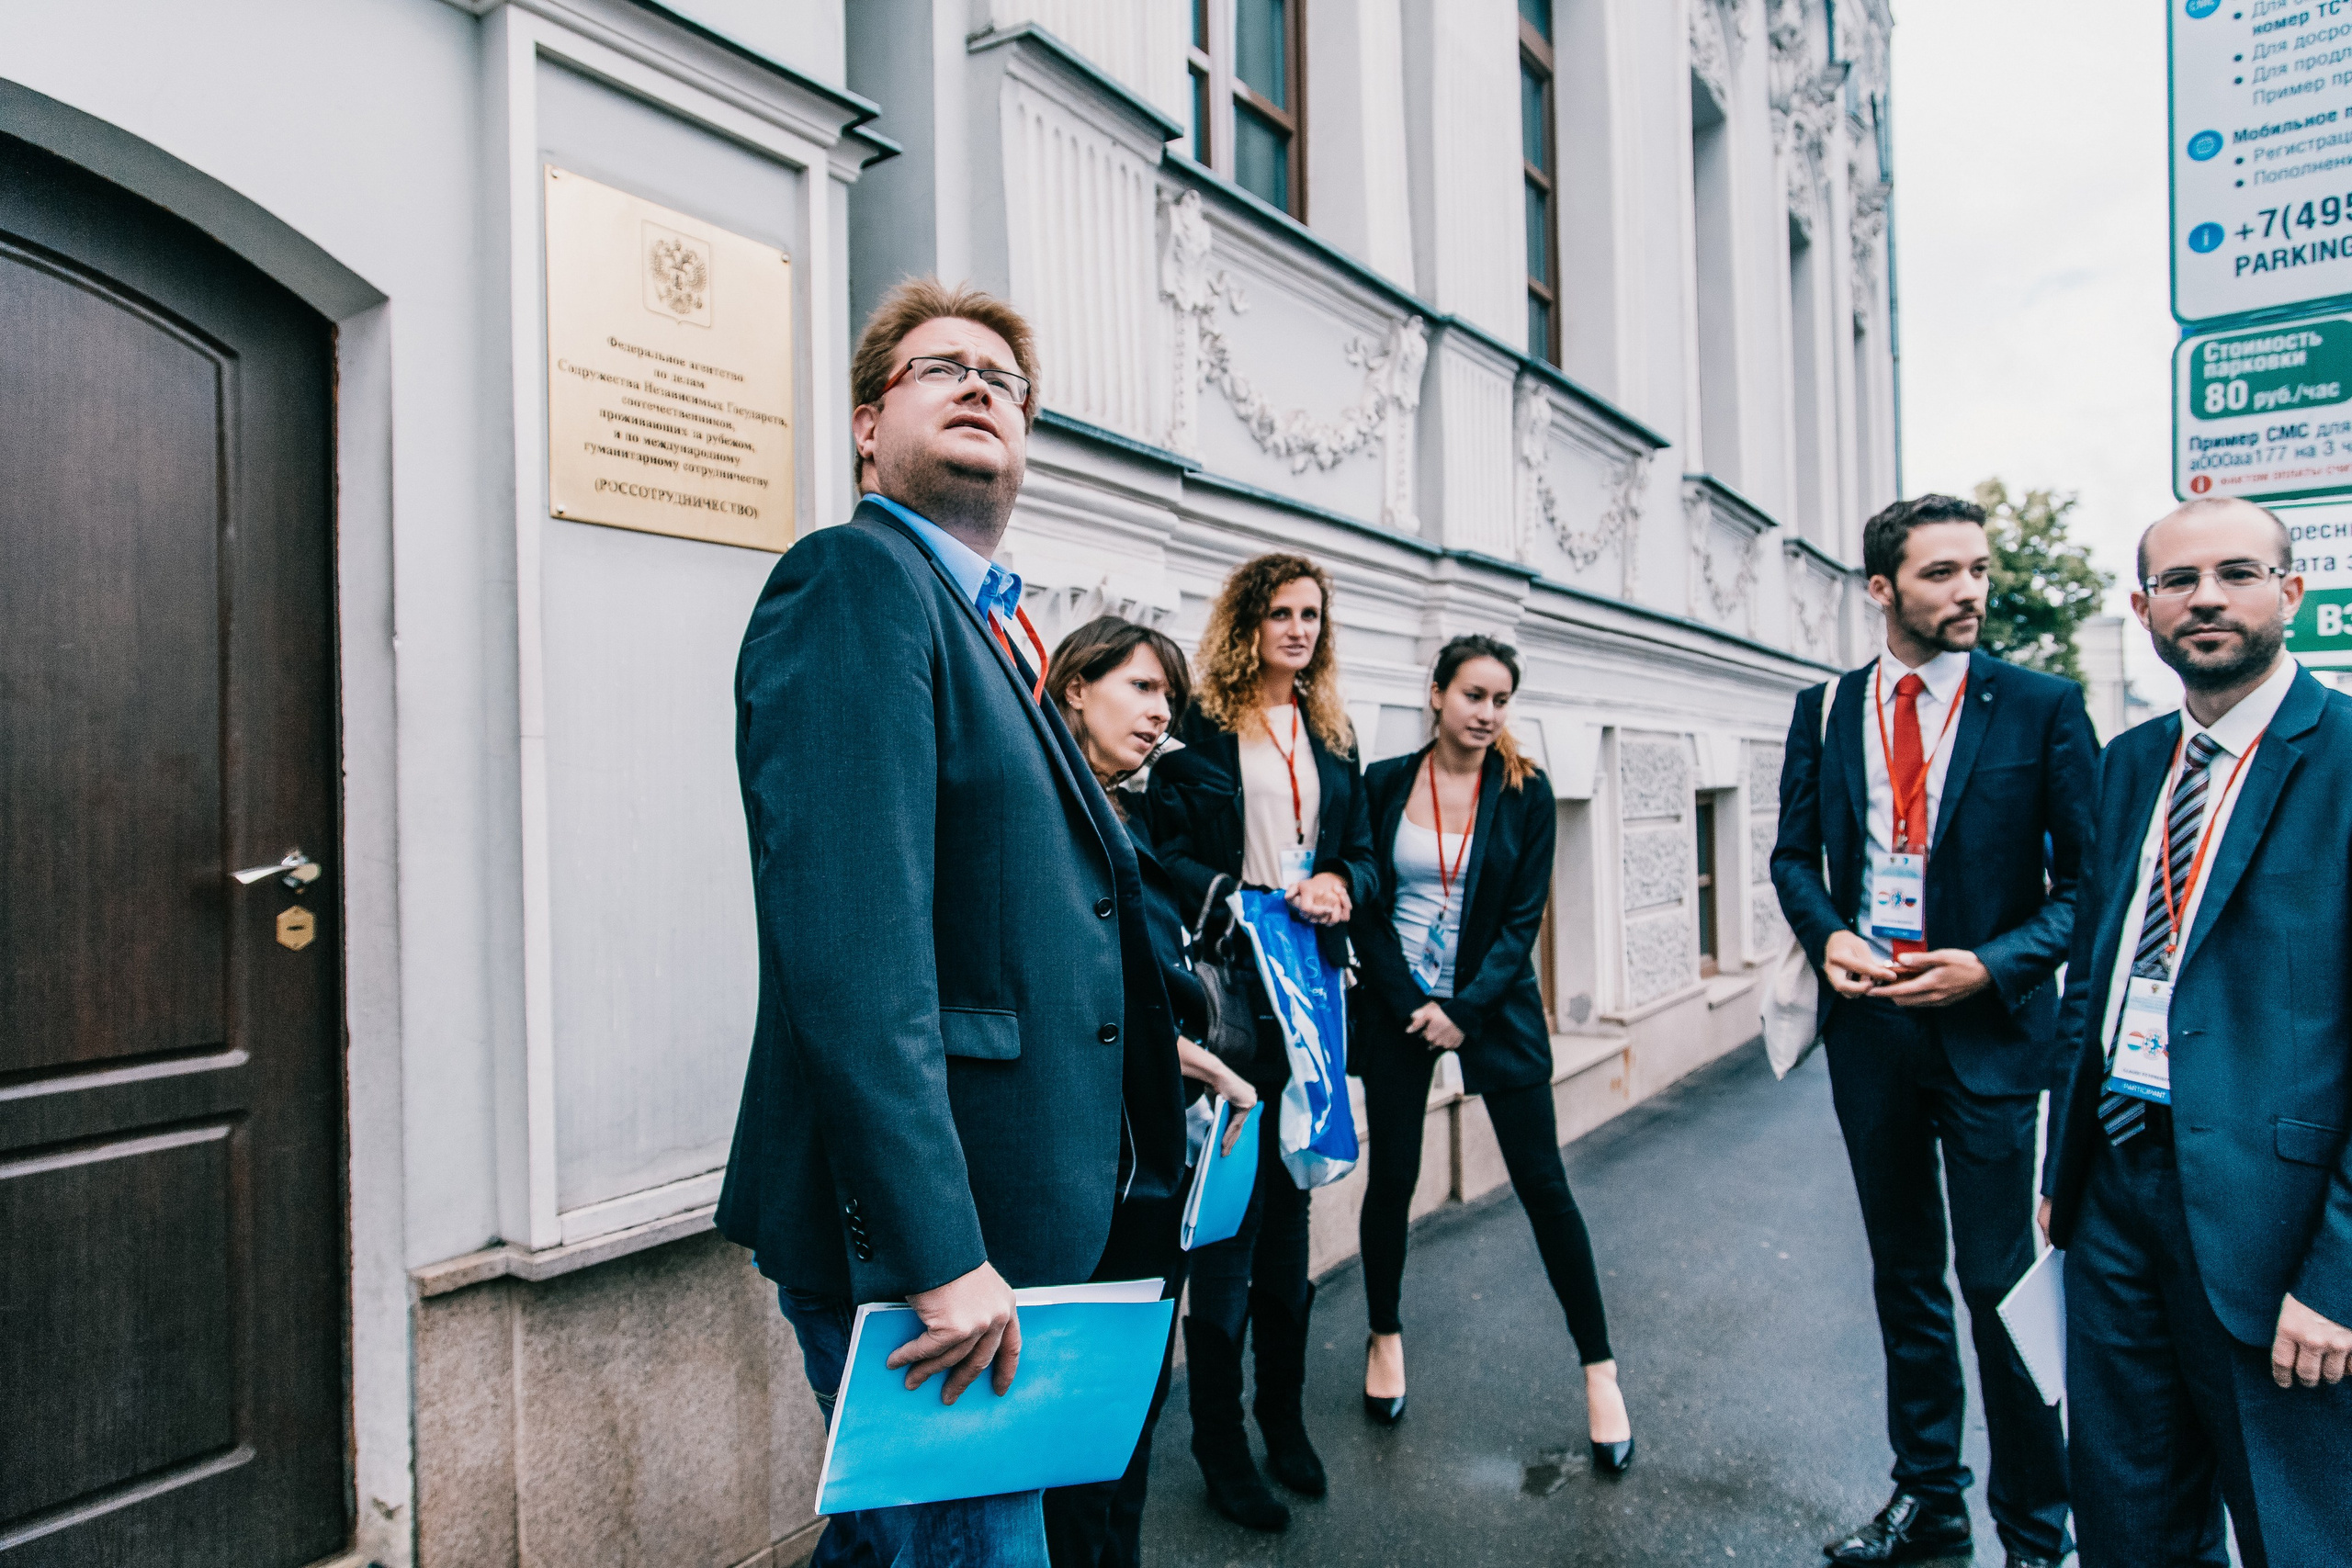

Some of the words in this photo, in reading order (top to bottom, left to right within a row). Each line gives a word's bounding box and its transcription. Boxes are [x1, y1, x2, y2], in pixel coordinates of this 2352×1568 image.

[2253, 11, 2309, 36] номер
[2252, 41, 2287, 62] Для
[2293, 23, 2352, 51] досро
[2252, 63, 2287, 84] Для
[2254, 78, 2325, 106] Пример
[2233, 111, 2337, 144] Мобильное
[607, 336, 685, 367] Федеральное
[689, 360, 743, 382] агентство
[2204, 331, 2324, 362] Стоимость
[653, 368, 667, 379] по
[671, 372, 706, 389] делам
[2204, 349, 2307, 379] парковки
[558, 357, 640, 389] Содружества
[644, 380, 724, 412] Независимых
[727, 400, 788, 429] Государств,
[2205, 379, 2249, 413] 80
[621, 395, 736, 433] соотечественников,
[600, 409, 687, 436] проживающих
[693, 431, 702, 440] за
[706, 433, 755, 454] рубежом,
[614, 429, 621, 439] и
[625, 432, 639, 443] по
[643, 436, 741, 467] международному
[2189, 432, 2259, 451] Пример
[2316, 421, 2352, 438] для
[583, 442, 679, 472] гуманитарному
[683, 462, 769, 489] сотрудничеству
[2295, 446, 2317, 459] на
[2324, 439, 2335, 457] 3
[594, 477, 758, 520] (РОССОТРУДНИЧЕСТВО)
[2293, 556, 2336, 572] ата
